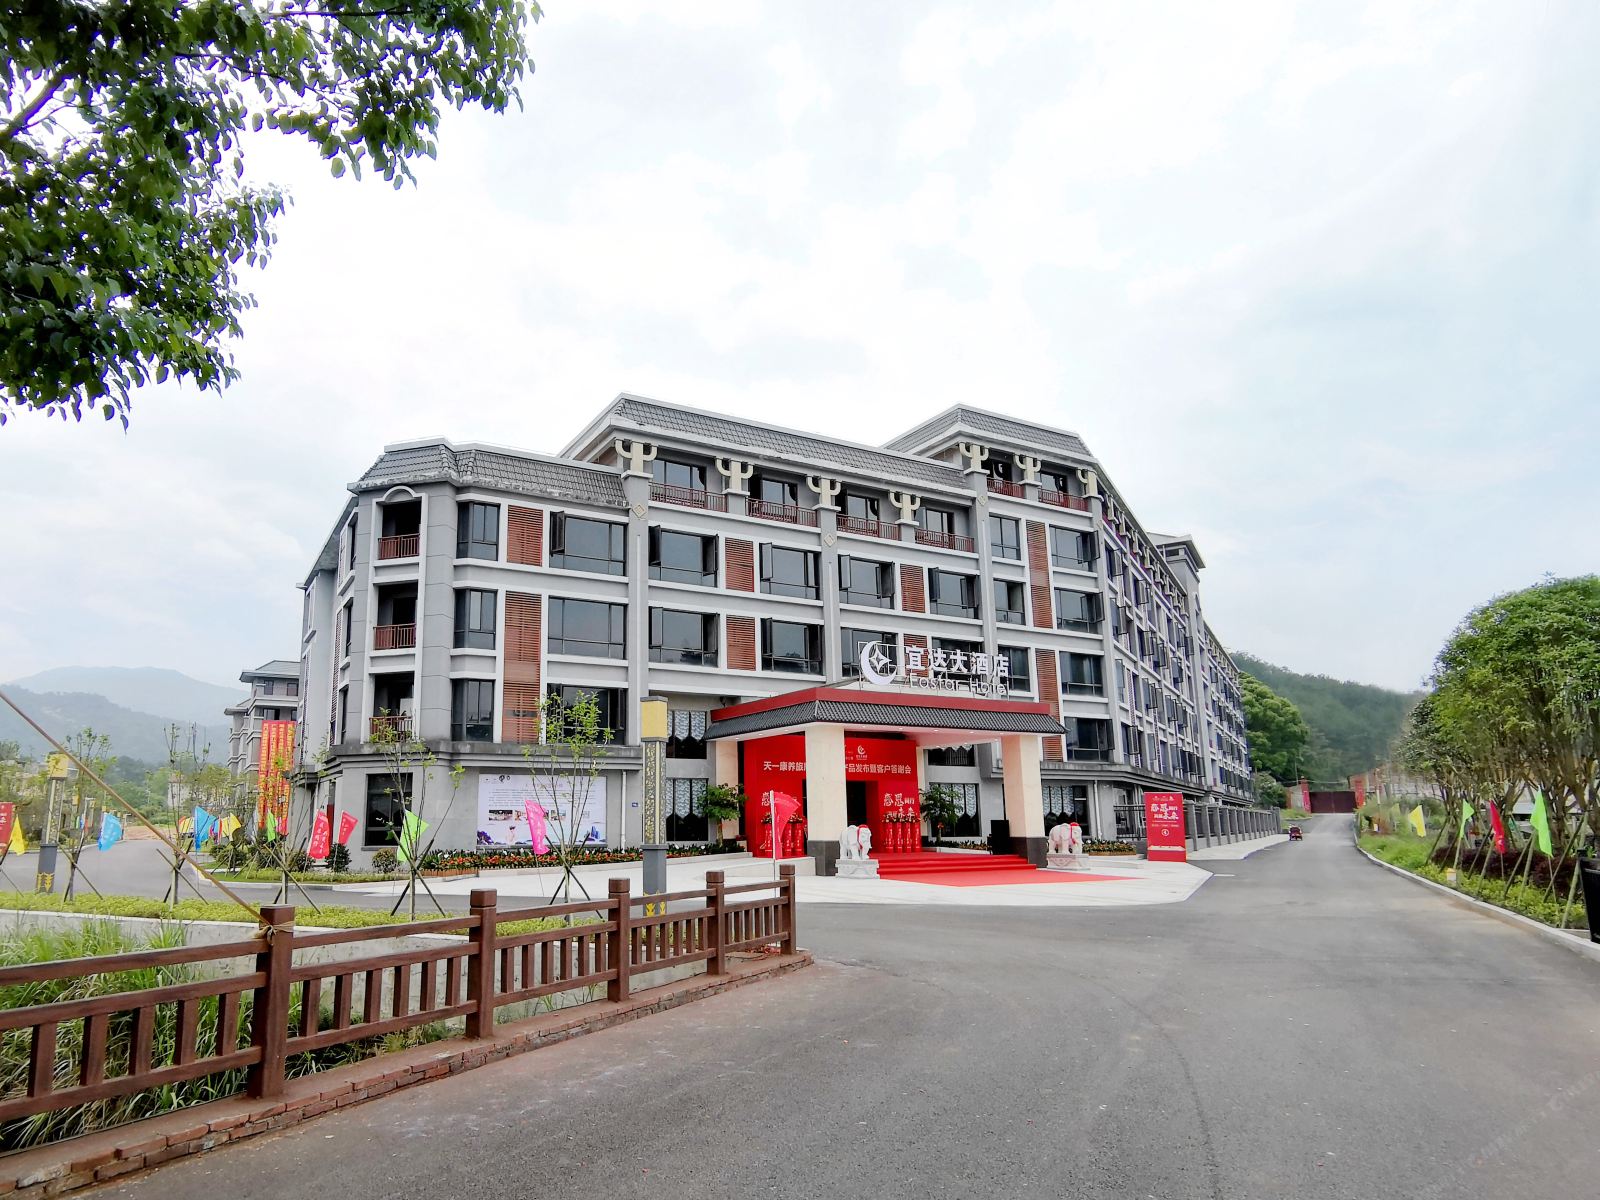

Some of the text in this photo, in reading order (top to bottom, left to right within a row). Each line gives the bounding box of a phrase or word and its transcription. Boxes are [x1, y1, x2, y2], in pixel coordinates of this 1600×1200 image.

[905, 645, 1009, 677] 宜达大酒店
[969, 677, 1010, 697] Hotel
[763, 761, 806, 772] 天一康养旅
